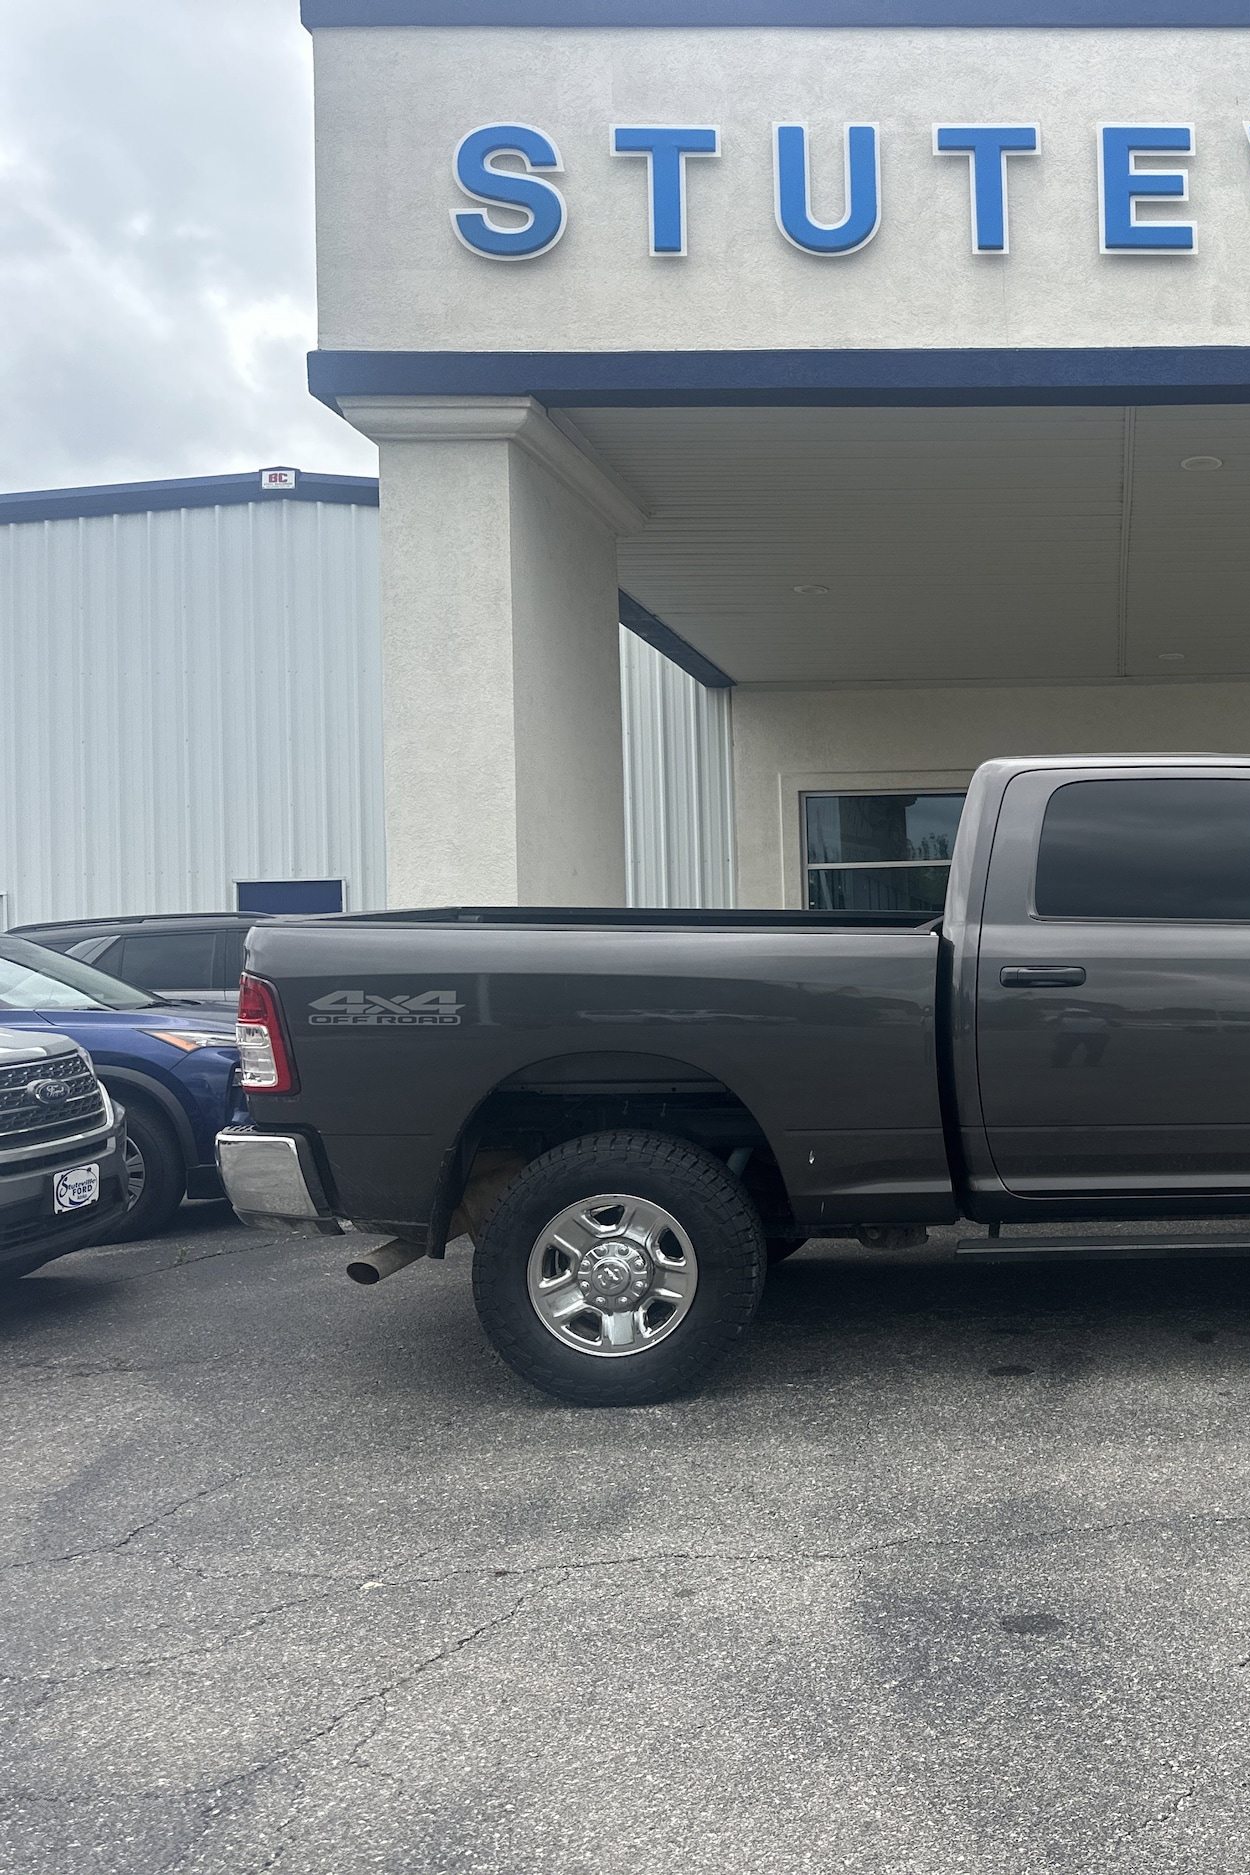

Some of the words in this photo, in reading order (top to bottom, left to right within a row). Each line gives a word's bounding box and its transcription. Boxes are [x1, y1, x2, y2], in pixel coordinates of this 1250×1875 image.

[269, 473, 288, 483] BC
[311, 1015, 371, 1025] OFF
[376, 1015, 460, 1025] ROAD
[72, 1184, 93, 1197] FORD
